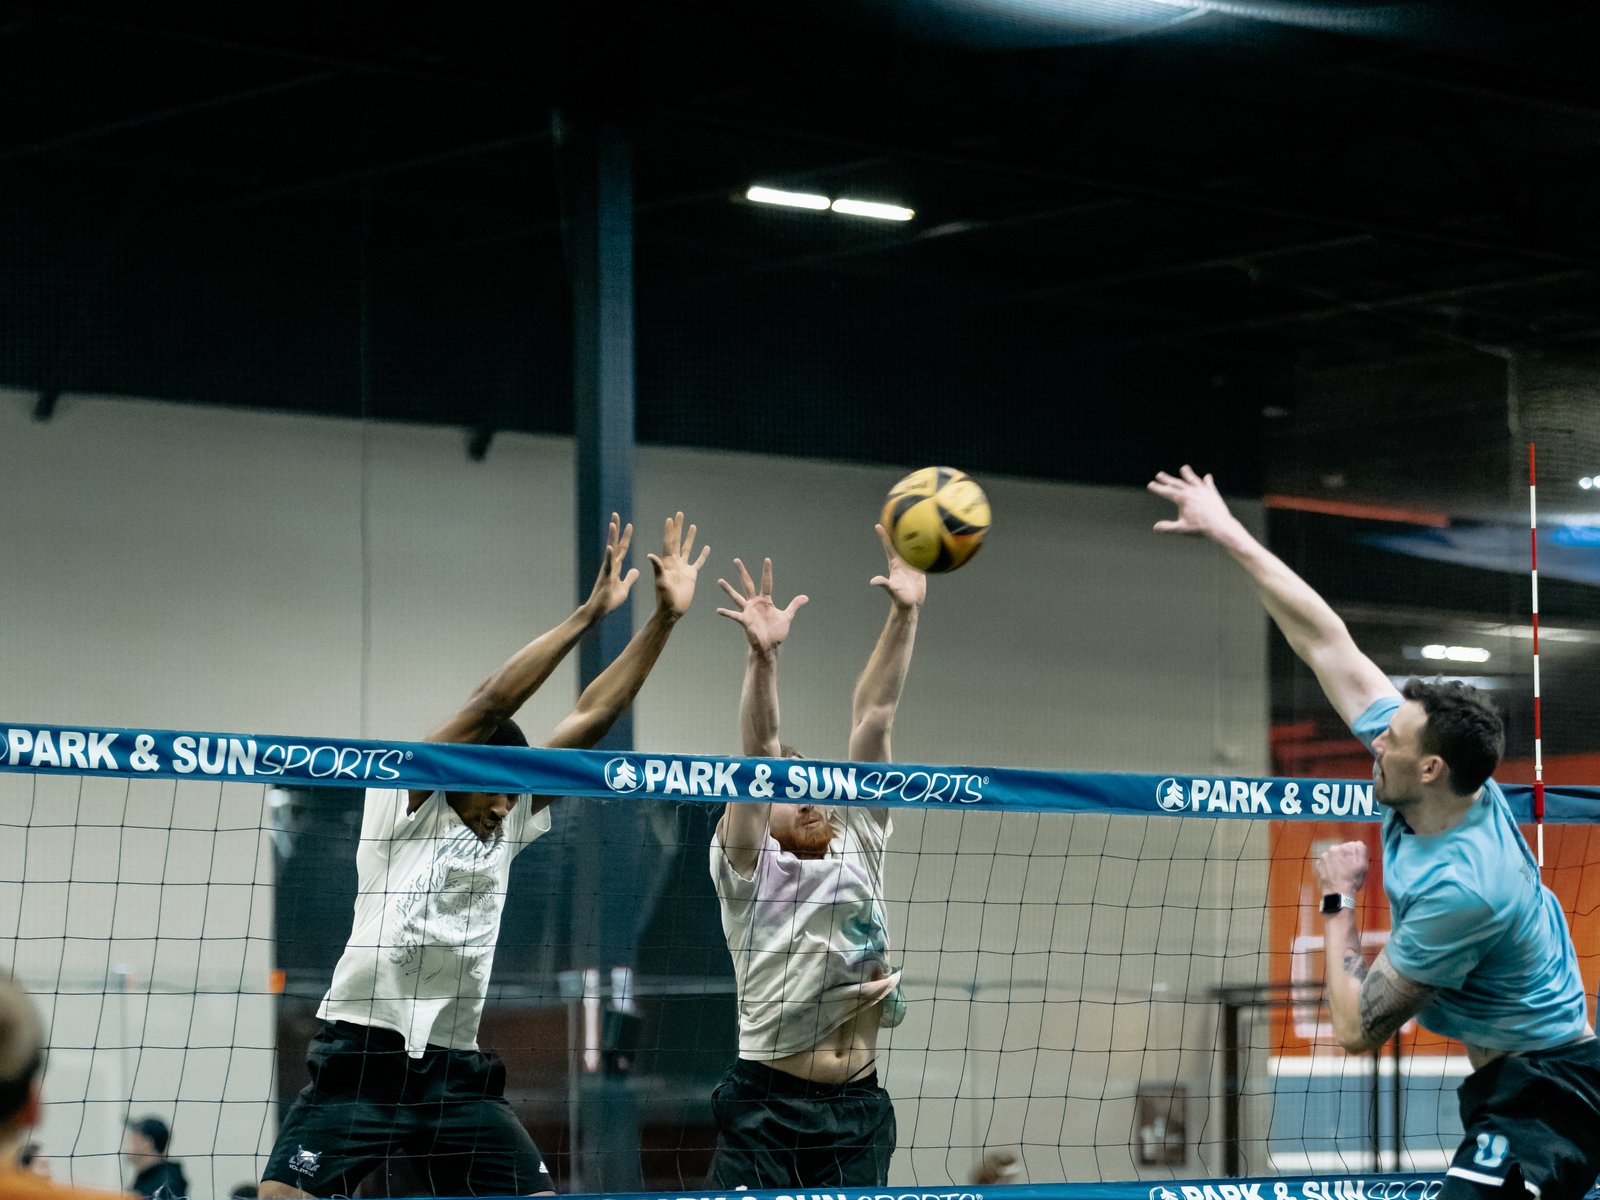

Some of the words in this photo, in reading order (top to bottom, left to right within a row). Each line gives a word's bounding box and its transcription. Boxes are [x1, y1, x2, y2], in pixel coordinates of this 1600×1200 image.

[7, 728, 120, 770] PARK
[130, 733, 161, 772] &
[644, 759, 741, 797] PARK
[748, 763, 775, 798] &
[1190, 779, 1273, 815] PARK
[1280, 782, 1303, 815] &
[1312, 783, 1375, 817] SUN
